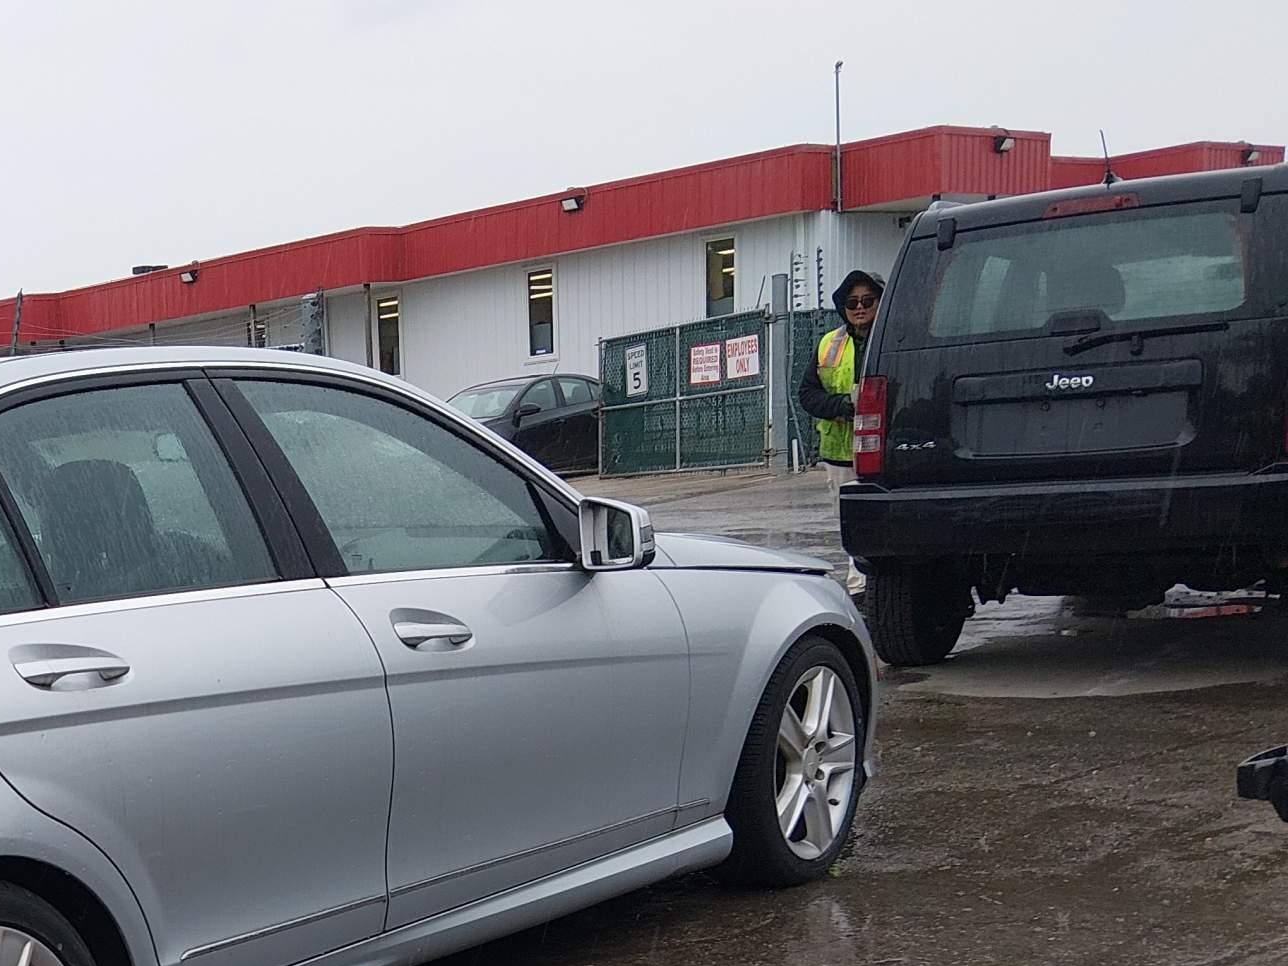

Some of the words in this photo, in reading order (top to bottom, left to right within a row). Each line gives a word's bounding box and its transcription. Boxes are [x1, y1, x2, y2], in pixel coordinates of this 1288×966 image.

[627, 350, 644, 360] SPEED
[727, 339, 758, 358] EMPLOYEES
[629, 360, 643, 370] LIMIT
[693, 355, 718, 365] REQUIRED
[735, 357, 750, 373] ONLY
[633, 371, 642, 390] 5
[1045, 374, 1094, 389] Jeep
